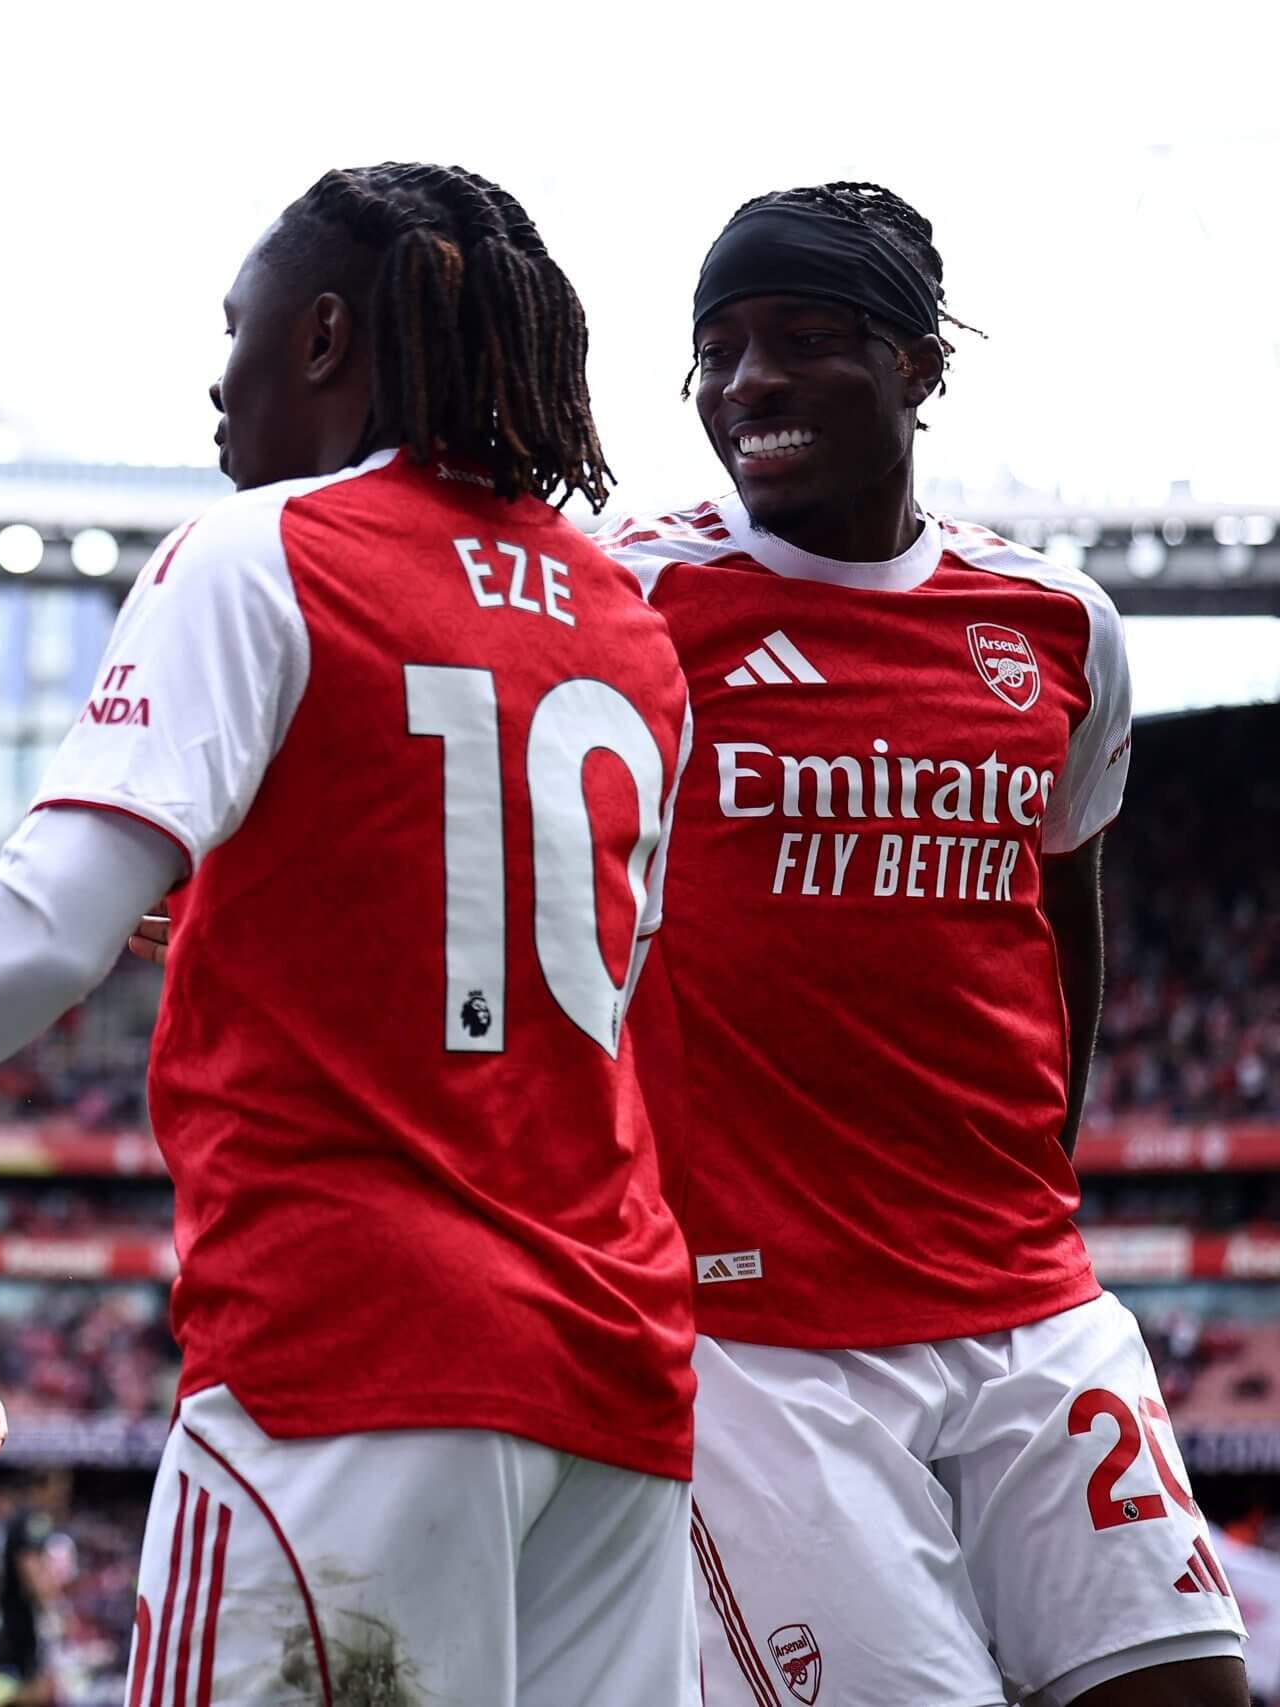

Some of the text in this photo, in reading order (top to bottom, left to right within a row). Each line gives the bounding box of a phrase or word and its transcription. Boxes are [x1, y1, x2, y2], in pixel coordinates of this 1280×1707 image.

[453, 538, 576, 627] EZE
[979, 636, 1026, 655] Arsenal
[80, 697, 149, 728] NDA
[403, 663, 663, 1061] 10
[772, 833, 1019, 901] FLY BETTER
[775, 1635, 808, 1658] Arsenal
